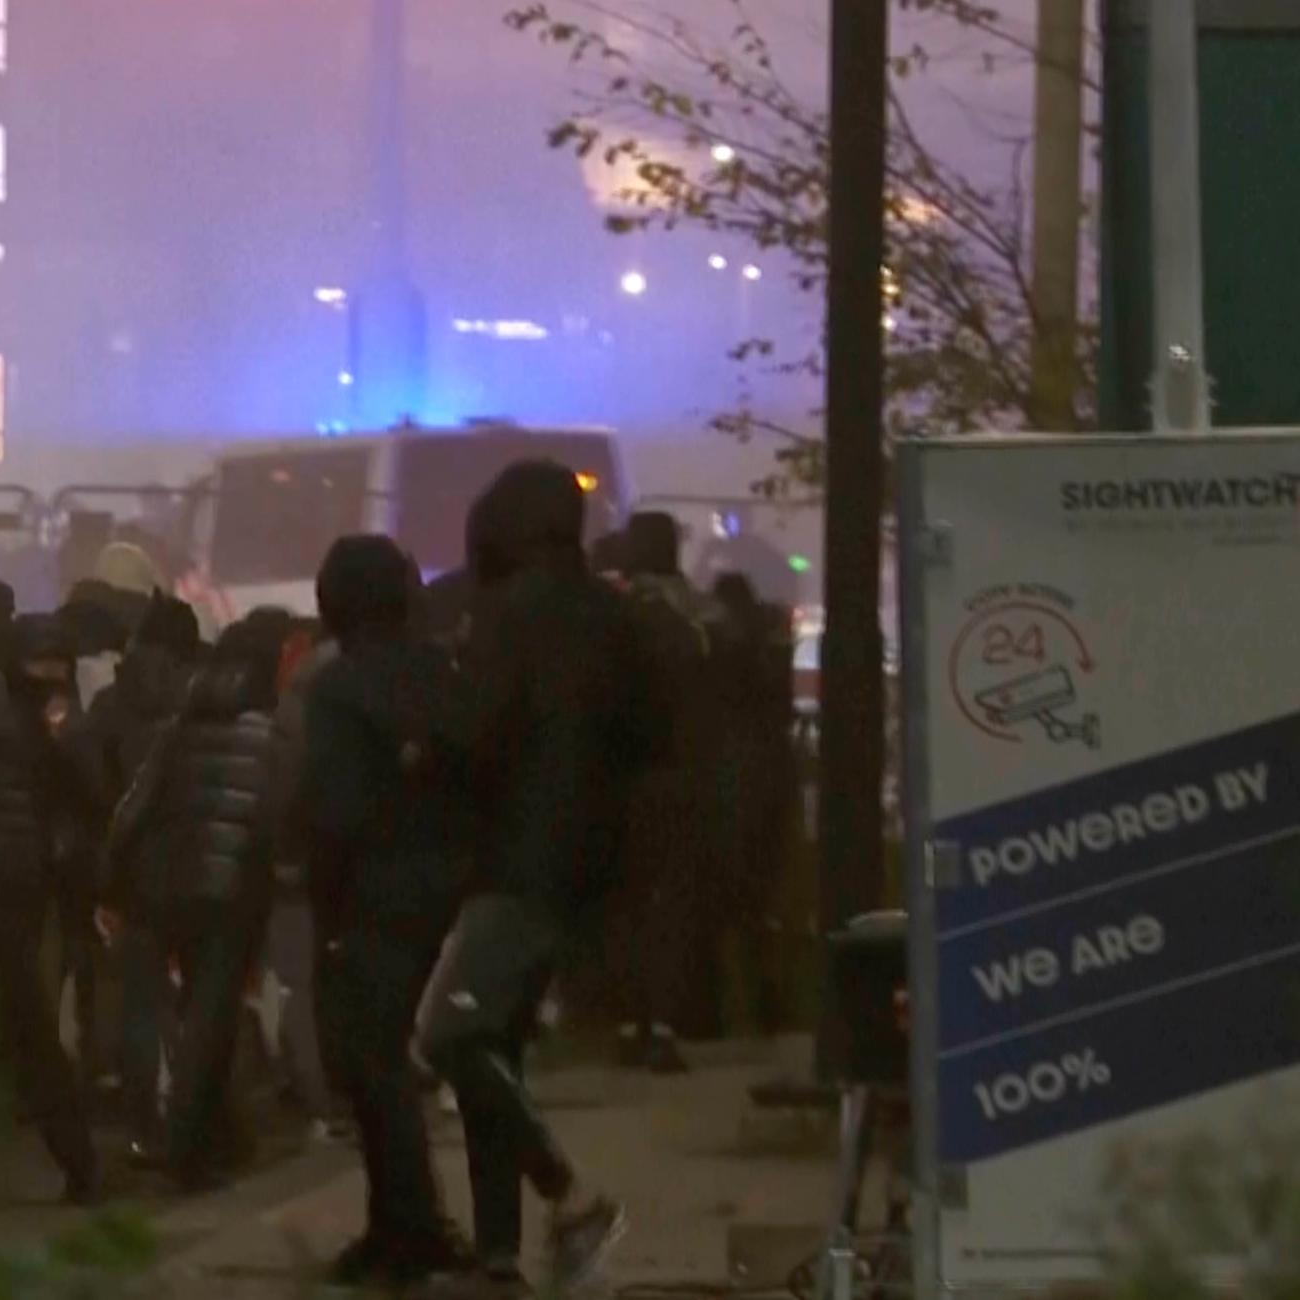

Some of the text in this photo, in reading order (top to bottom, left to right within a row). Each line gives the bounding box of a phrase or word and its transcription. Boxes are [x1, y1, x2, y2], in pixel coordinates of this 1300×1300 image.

[1061, 477, 1298, 511] SIGHTWATCH
[983, 623, 1045, 664] 24
[1213, 762, 1269, 812] BY
[973, 1047, 1112, 1122] 100%
